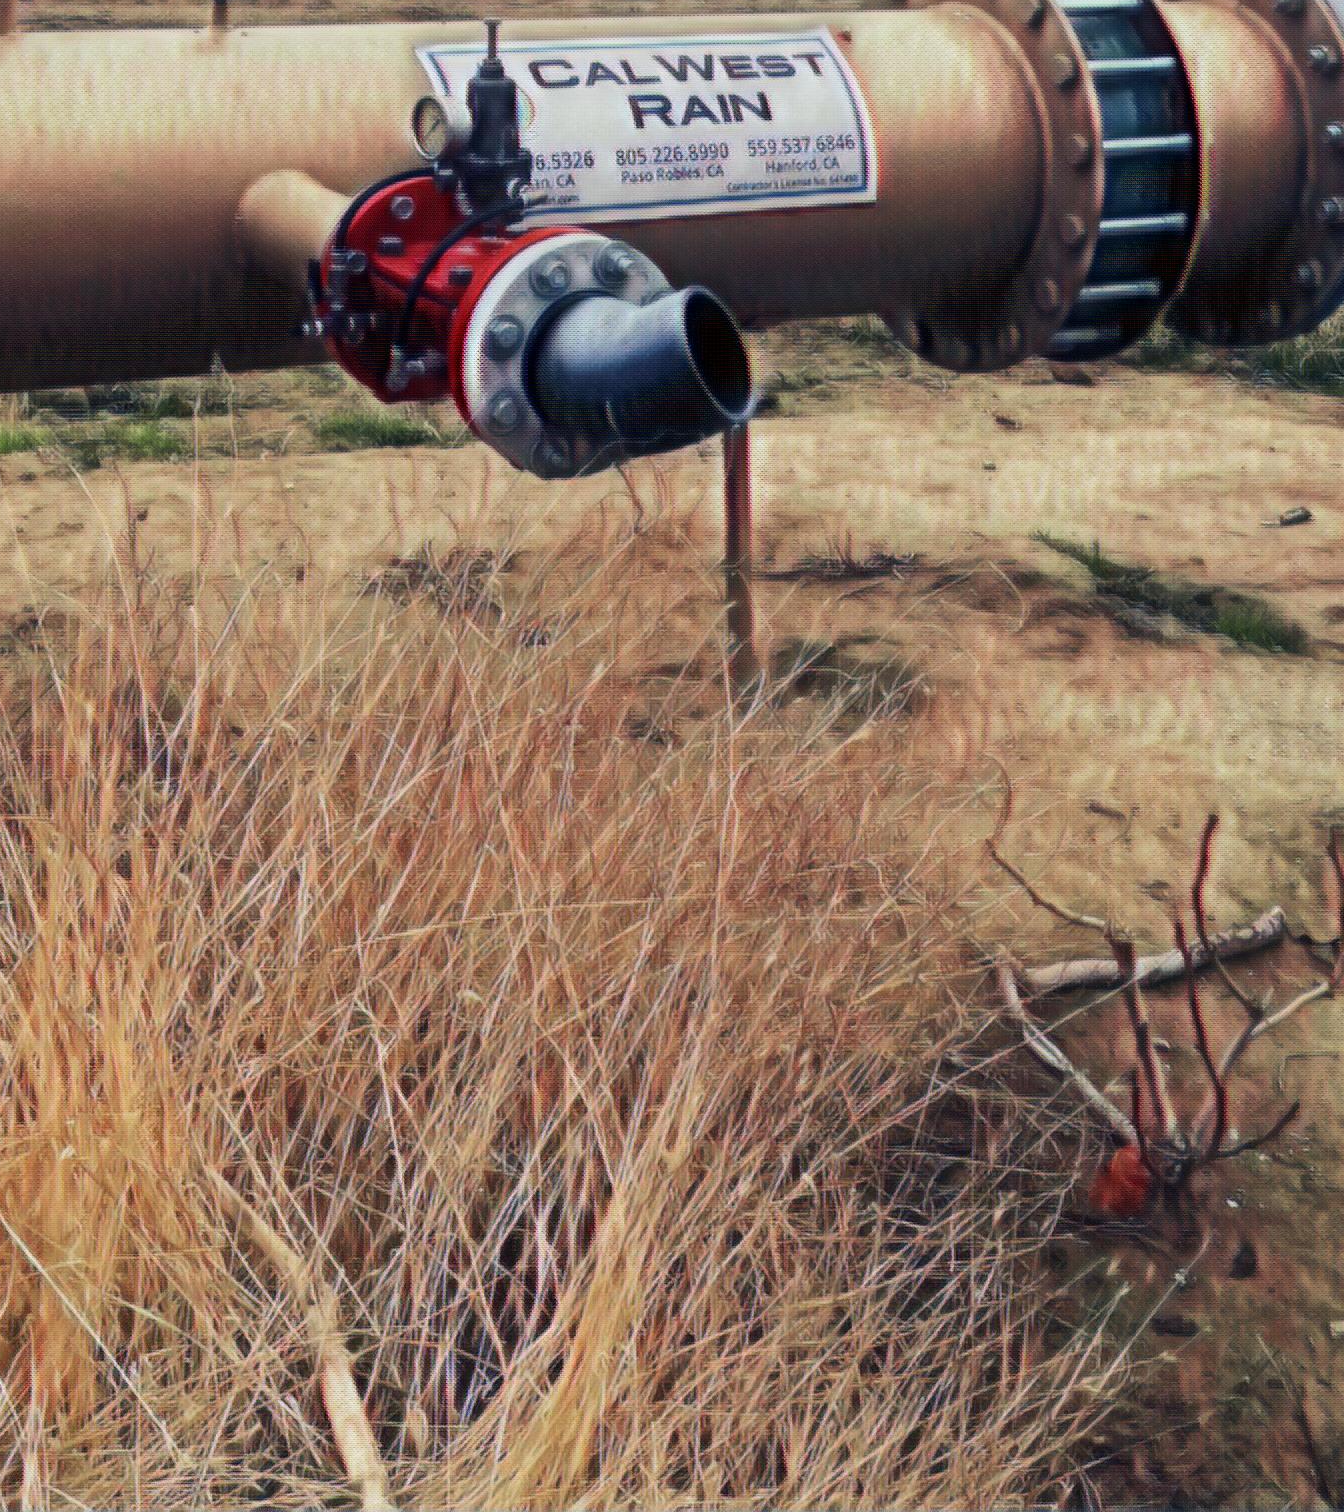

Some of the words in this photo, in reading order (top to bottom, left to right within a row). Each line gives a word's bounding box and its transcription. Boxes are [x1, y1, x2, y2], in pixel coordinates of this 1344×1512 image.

[527, 51, 826, 89] CALWEST
[628, 91, 773, 129] RAIN
[616, 142, 730, 166] 805.226.8990
[747, 134, 856, 157] 559.537.6846
[621, 170, 654, 184] Paso
[706, 163, 725, 178] CA
[823, 156, 841, 170] CA
